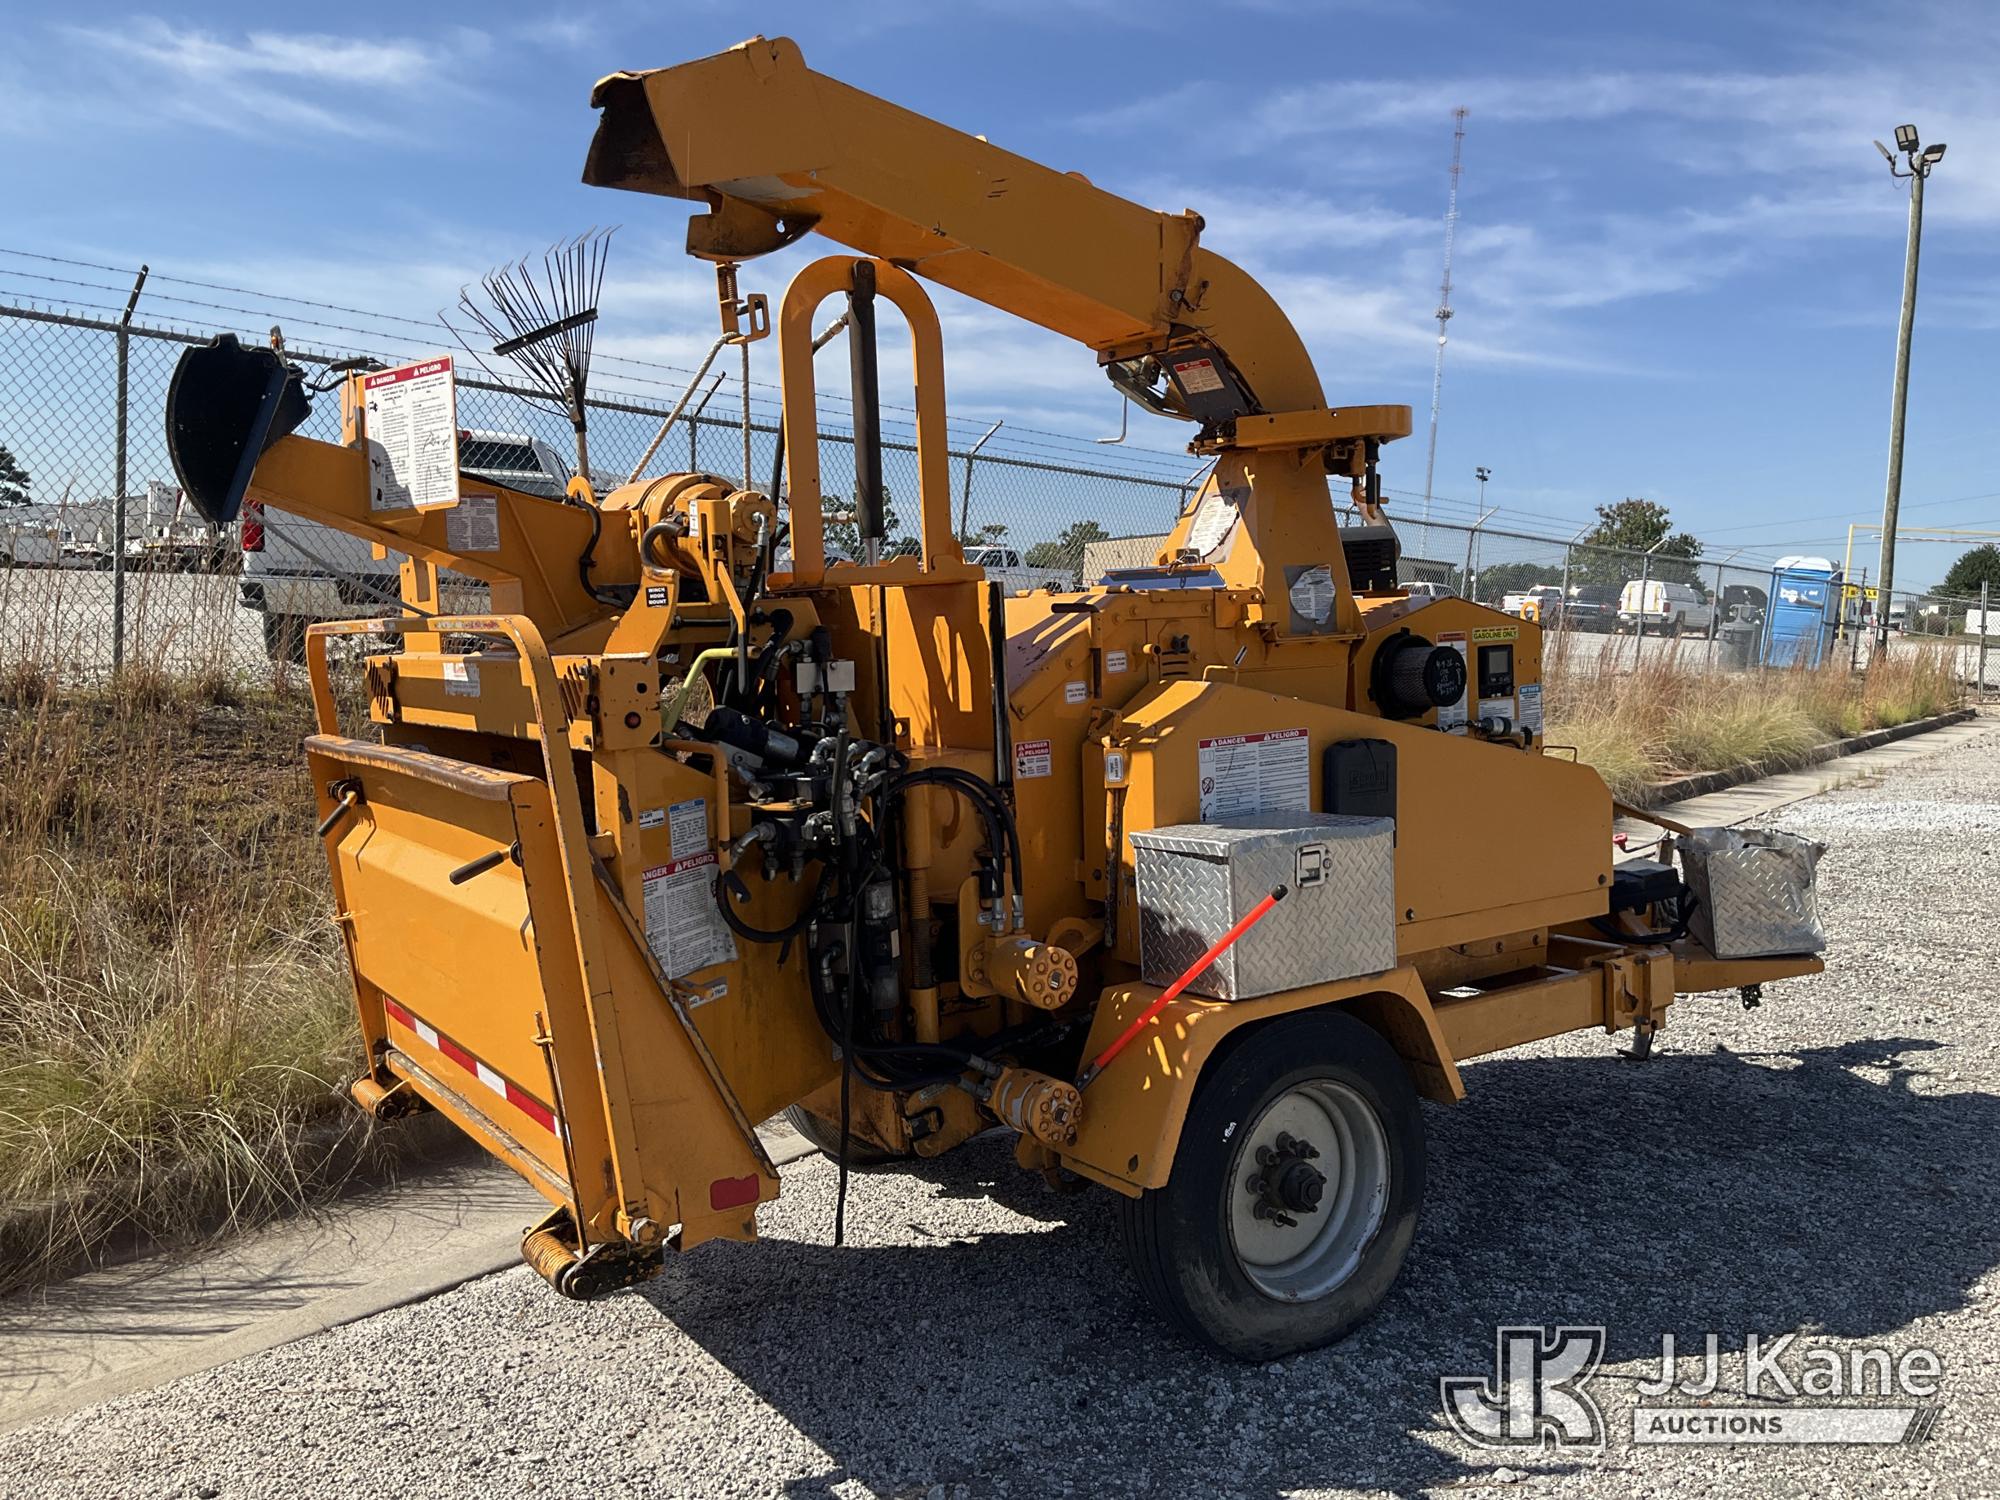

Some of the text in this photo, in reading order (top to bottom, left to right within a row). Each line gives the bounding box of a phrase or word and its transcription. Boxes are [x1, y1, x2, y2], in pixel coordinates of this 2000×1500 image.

[420, 363, 442, 374] PELIGRO
[376, 374, 396, 384] DANGER
[1474, 632, 1502, 640] GASOLINE
[1271, 730, 1299, 740] PELIGRO
[1218, 736, 1246, 746] DANGER
[682, 854, 714, 870] PELIGRO
[642, 866, 667, 880] ANGER
